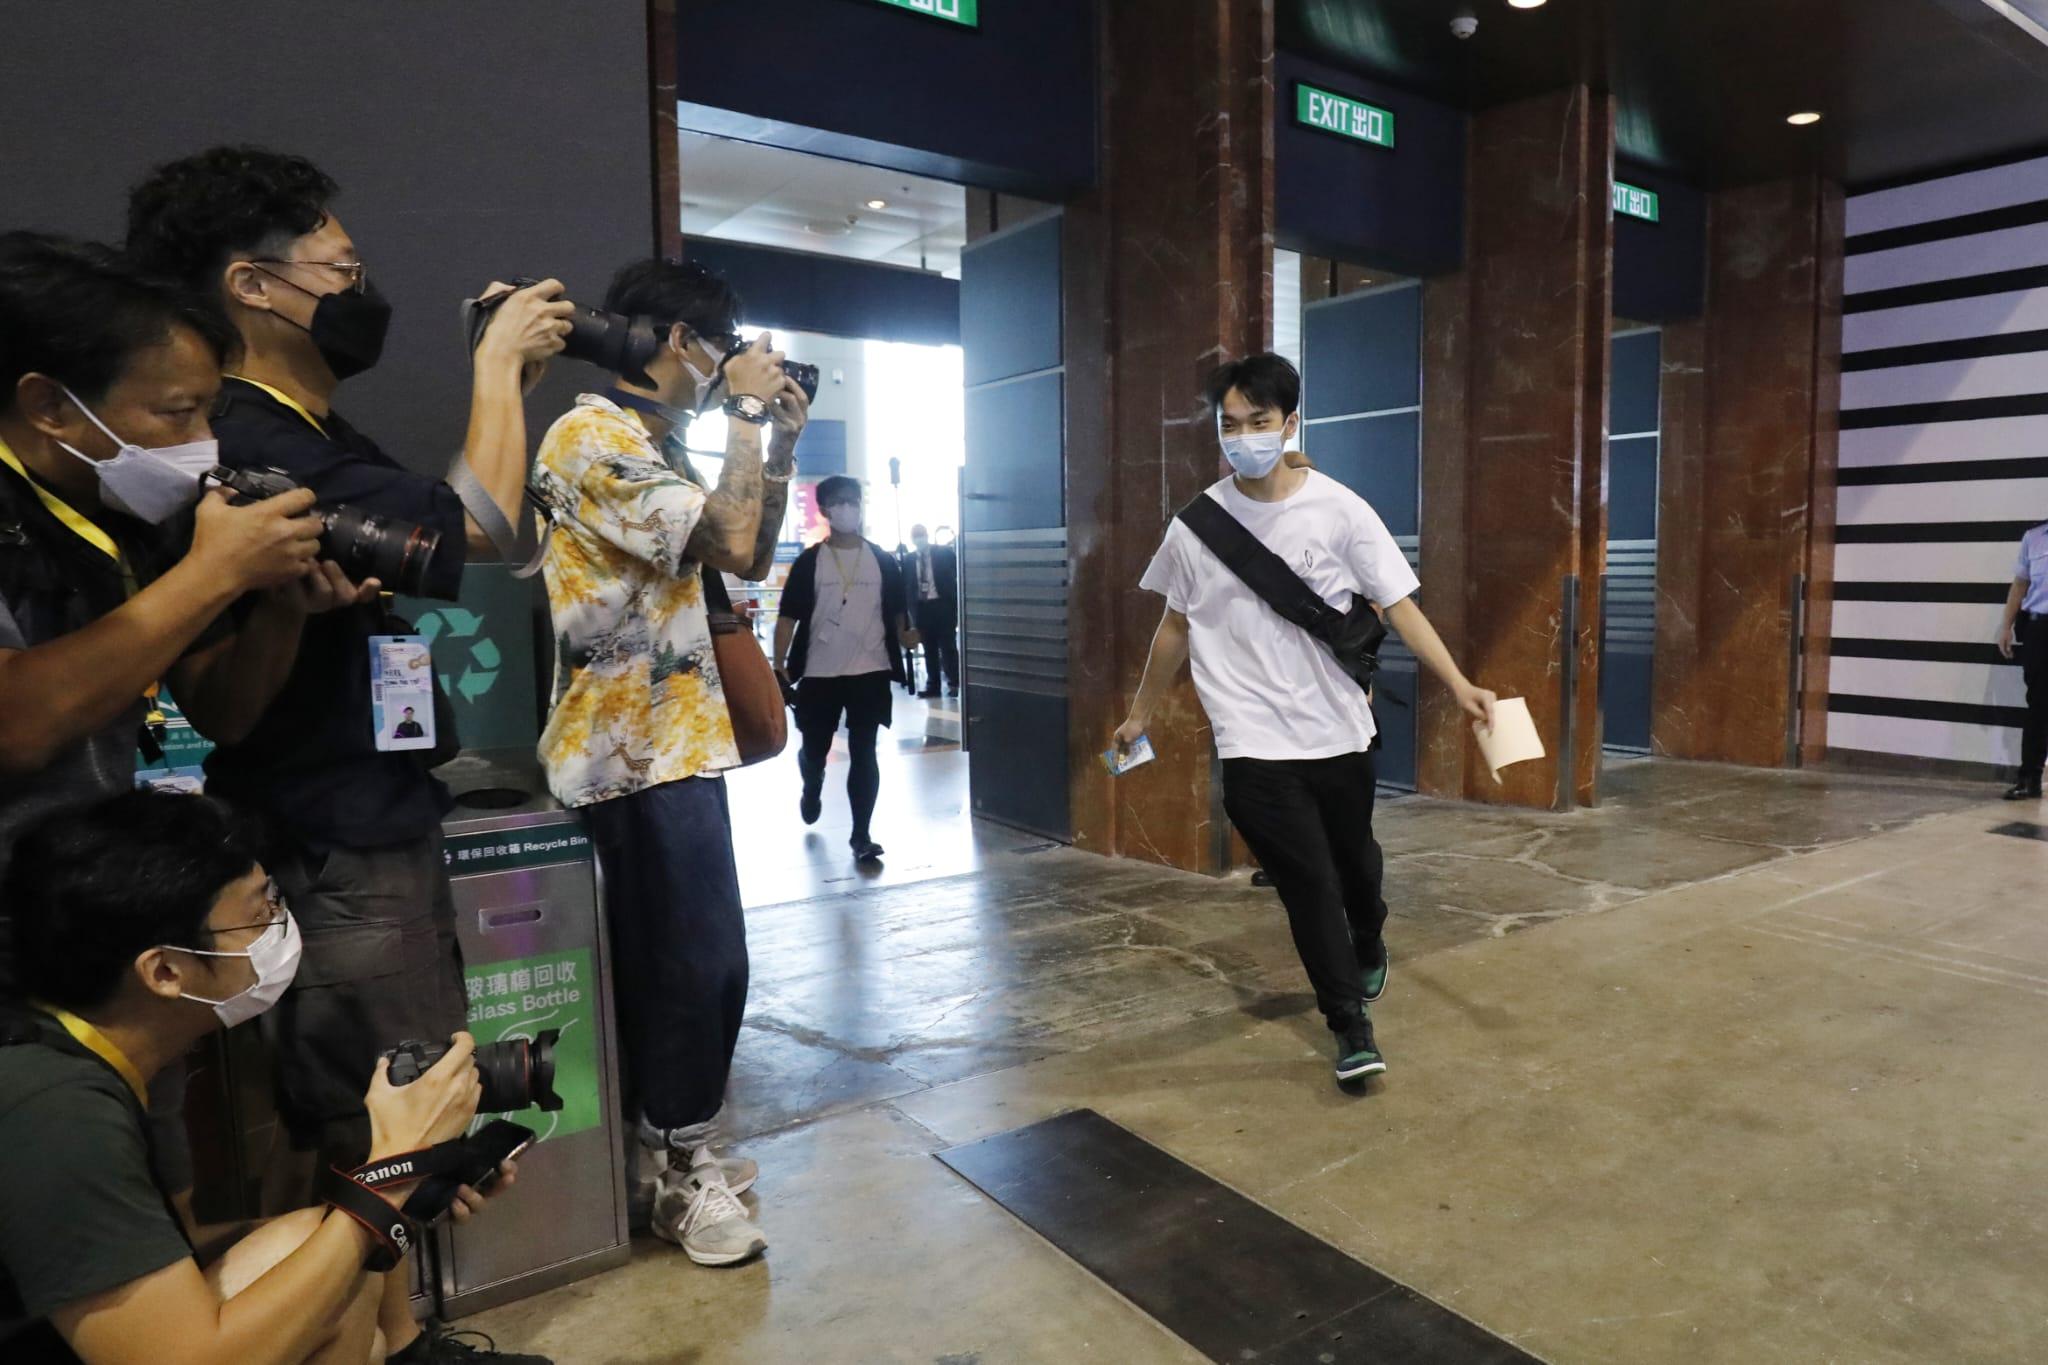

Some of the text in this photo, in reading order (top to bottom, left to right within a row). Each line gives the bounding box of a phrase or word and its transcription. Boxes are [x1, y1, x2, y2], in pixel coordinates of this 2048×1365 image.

[1309, 92, 1382, 142] EXIT 出口
[1629, 189, 1651, 218] 出口
[523, 838, 568, 852] Recycle
[570, 836, 588, 846] Bin
[466, 987, 582, 1023] Glass Bottle
[353, 1160, 414, 1185] Canon
